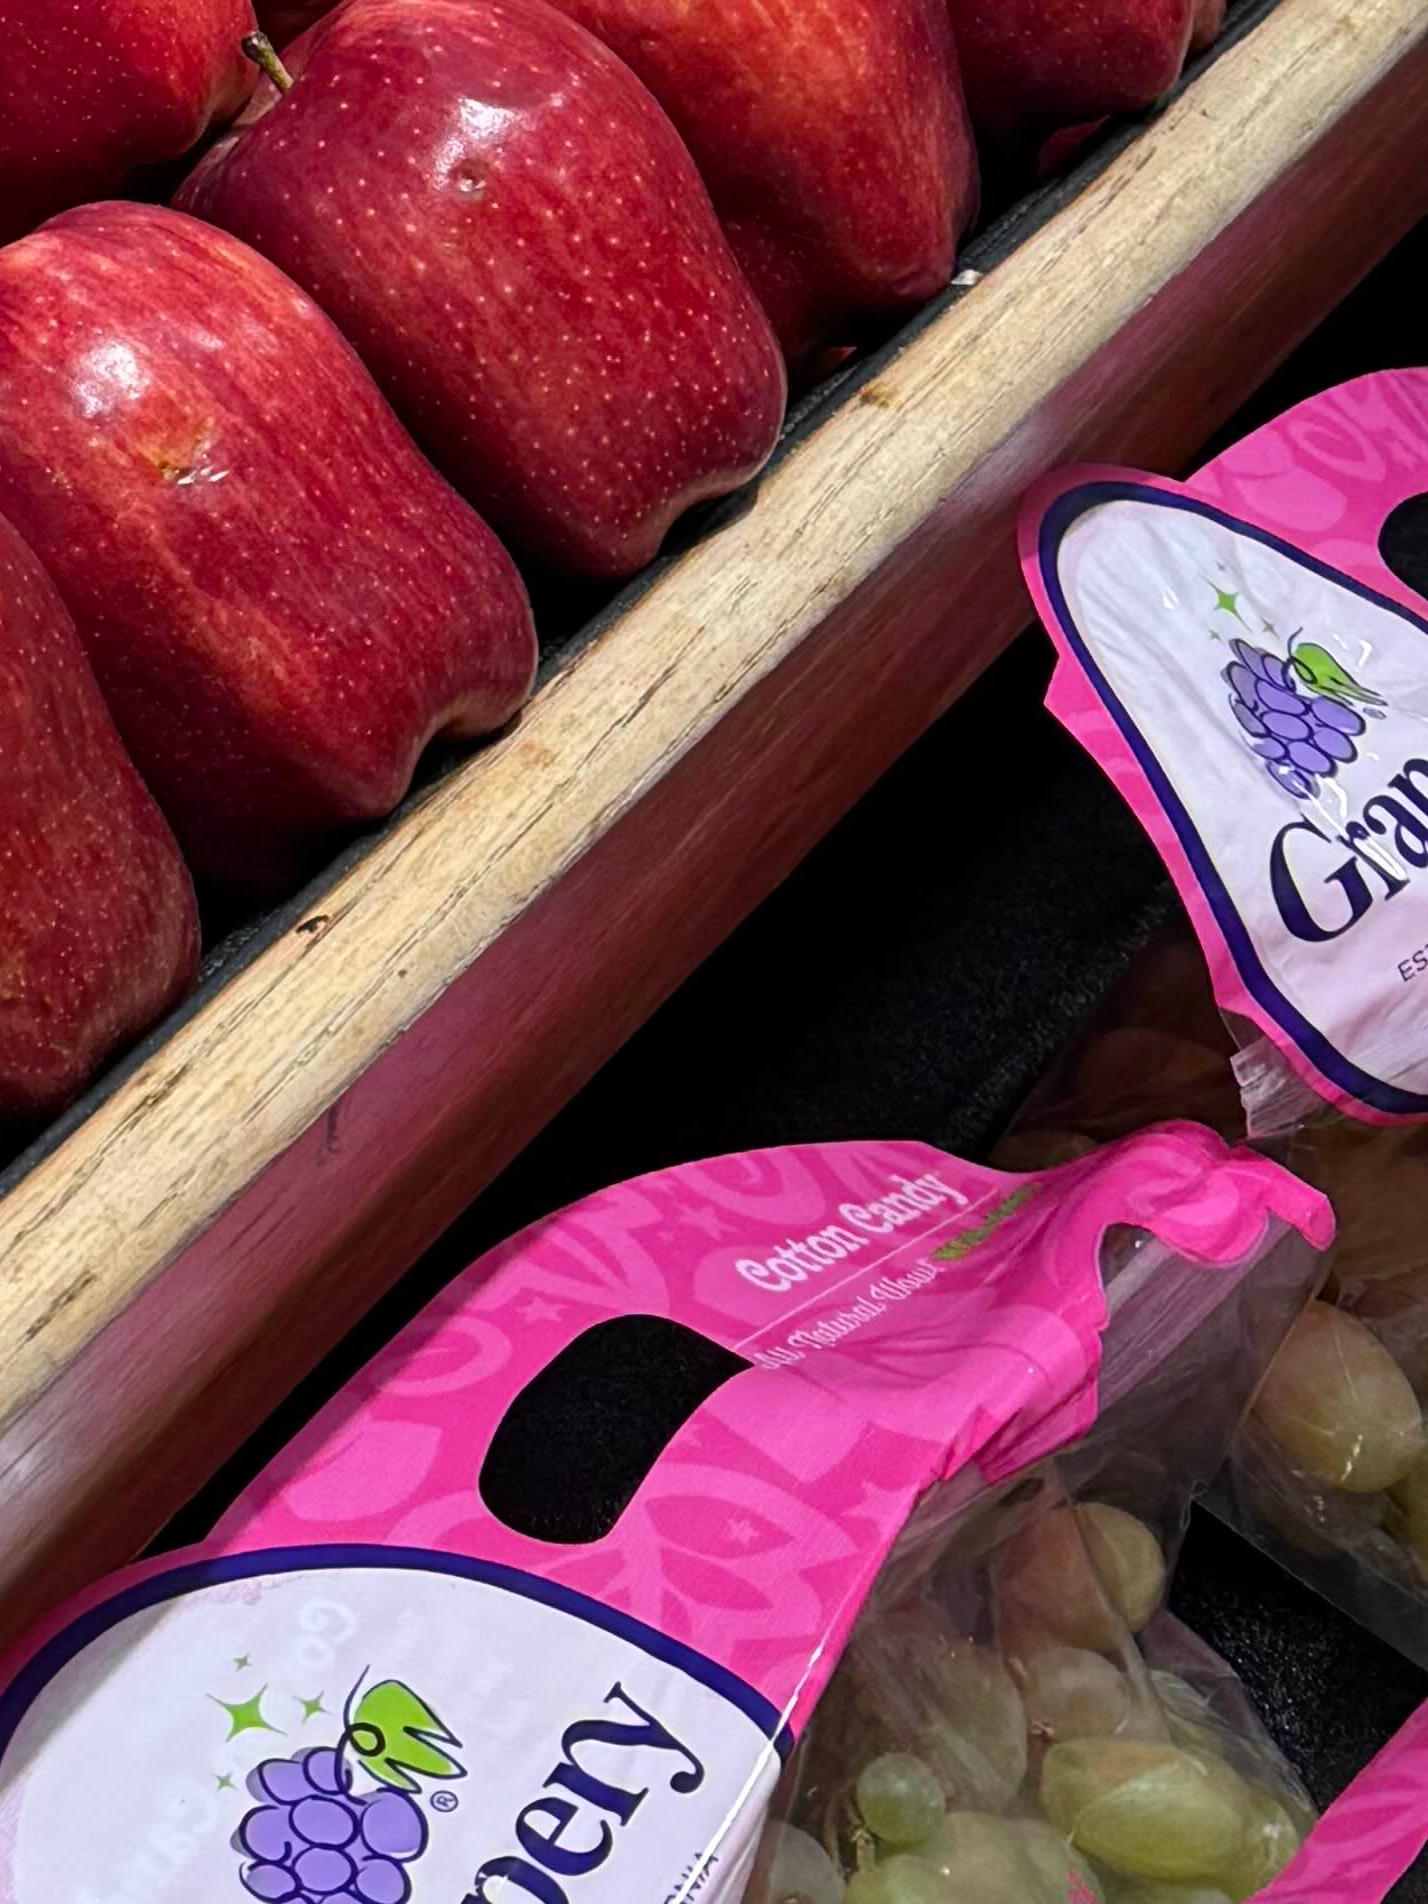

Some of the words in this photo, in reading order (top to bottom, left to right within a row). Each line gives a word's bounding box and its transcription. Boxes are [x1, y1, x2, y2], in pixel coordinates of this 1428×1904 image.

[1396, 944, 1428, 983] ES
[735, 1224, 870, 1293] Cotton
[839, 1171, 970, 1234] Candy
[787, 1295, 887, 1350] Natural
